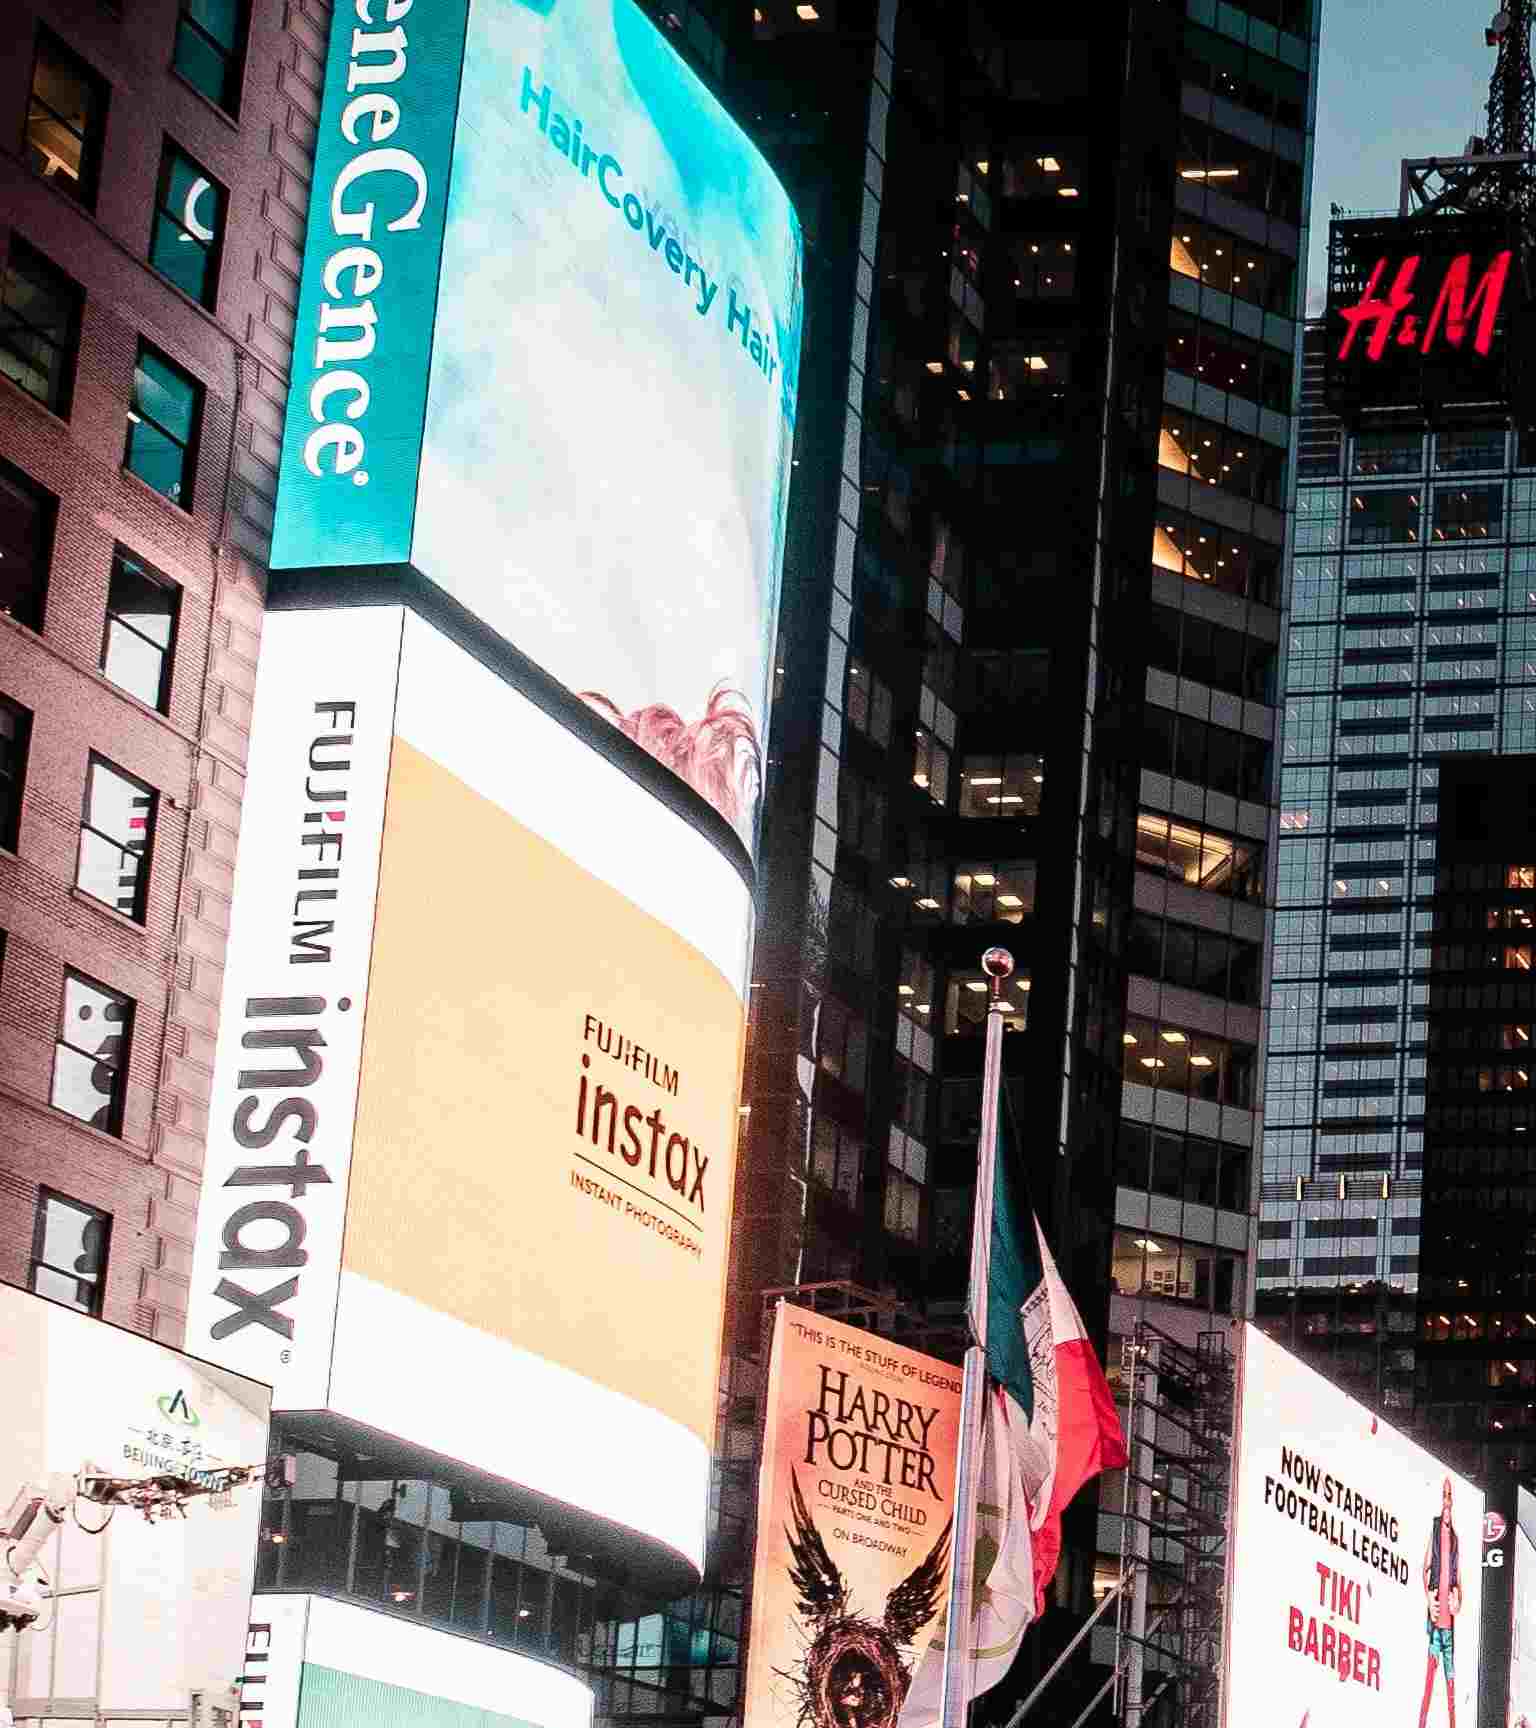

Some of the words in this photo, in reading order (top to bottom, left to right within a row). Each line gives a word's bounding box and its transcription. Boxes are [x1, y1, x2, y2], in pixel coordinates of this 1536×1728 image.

[520, 65, 719, 315] HairCovery
[726, 287, 778, 383] Hair
[1337, 250, 1513, 361] H&M
[289, 700, 357, 965] FUJIFILM
[584, 1013, 680, 1098] FUJIFILM
[209, 995, 351, 1341] instax
[575, 1053, 711, 1214] instax
[569, 1169, 624, 1211] INSTANT
[624, 1200, 704, 1258] PHOTOGRAPHY
[825, 1336, 837, 1349] IS
[840, 1340, 862, 1359] THE
[865, 1350, 899, 1372] STUFF
[902, 1364, 919, 1379] OF
[816, 1364, 939, 1451] HARRY
[804, 1410, 944, 1502] POTTER
[854, 1478, 874, 1493] AND
[876, 1484, 893, 1498] THE
[1281, 1446, 1320, 1494] NOW
[1324, 1474, 1399, 1543] STARRING
[818, 1479, 877, 1511] CURSED
[880, 1499, 927, 1526] CHILD
[833, 1528, 850, 1542] ON
[852, 1532, 909, 1558] BROADWAY
[1265, 1475, 1348, 1551] FOOTBALL
[1352, 1528, 1409, 1585] LEGEND
[1316, 1561, 1361, 1624] TIKI
[1481, 1548, 1504, 1568] G
[1288, 1605, 1381, 1692] BARBER
